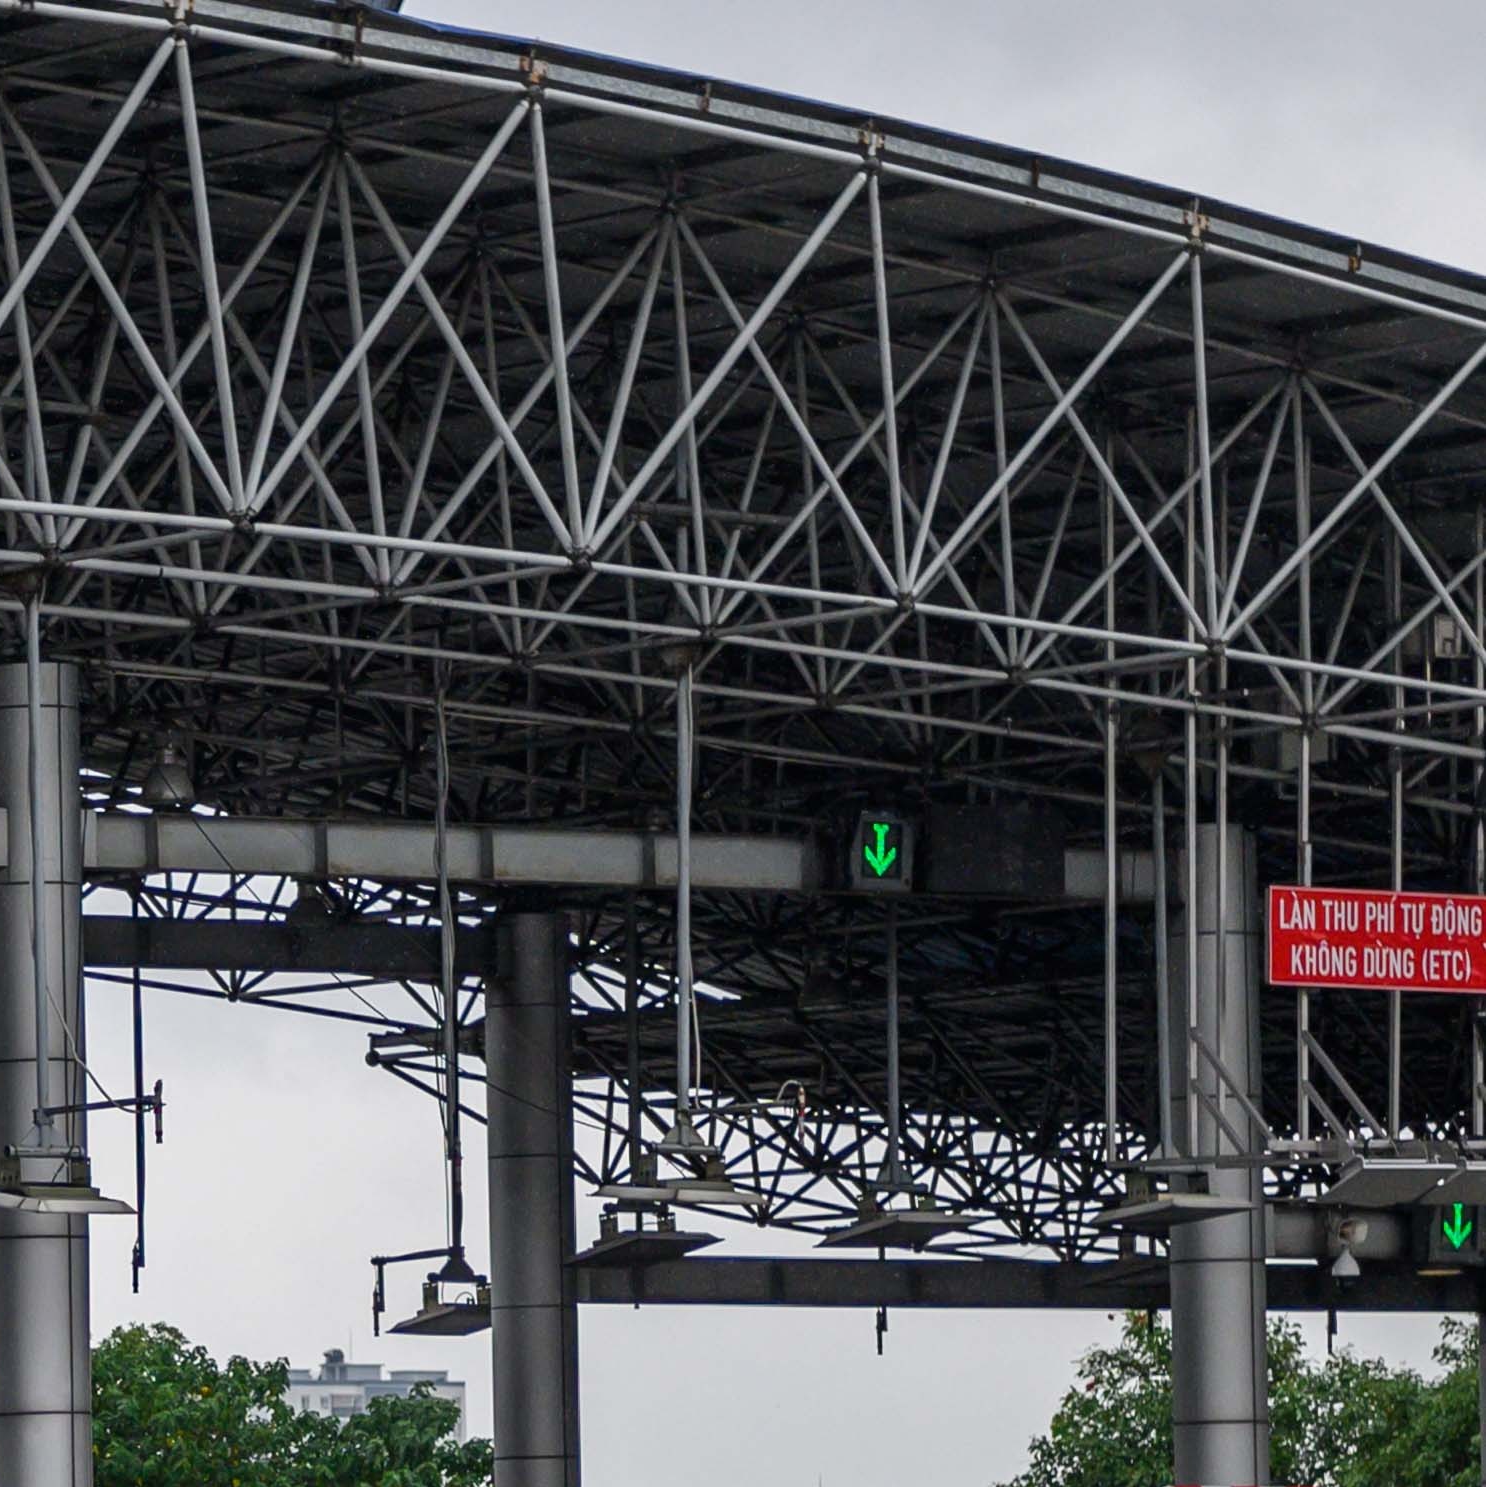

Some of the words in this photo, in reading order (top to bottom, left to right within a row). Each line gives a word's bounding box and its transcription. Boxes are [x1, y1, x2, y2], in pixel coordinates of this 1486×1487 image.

[1279, 891, 1316, 931] LÀN
[1322, 899, 1359, 932] THU
[1365, 894, 1397, 933] PHÍ
[1401, 902, 1425, 940] TỰ
[1431, 897, 1483, 941] ĐỘNG
[1291, 939, 1357, 978] KHÔNG
[1363, 939, 1415, 979] DỪNG
[1422, 948, 1472, 983] (ETC)
